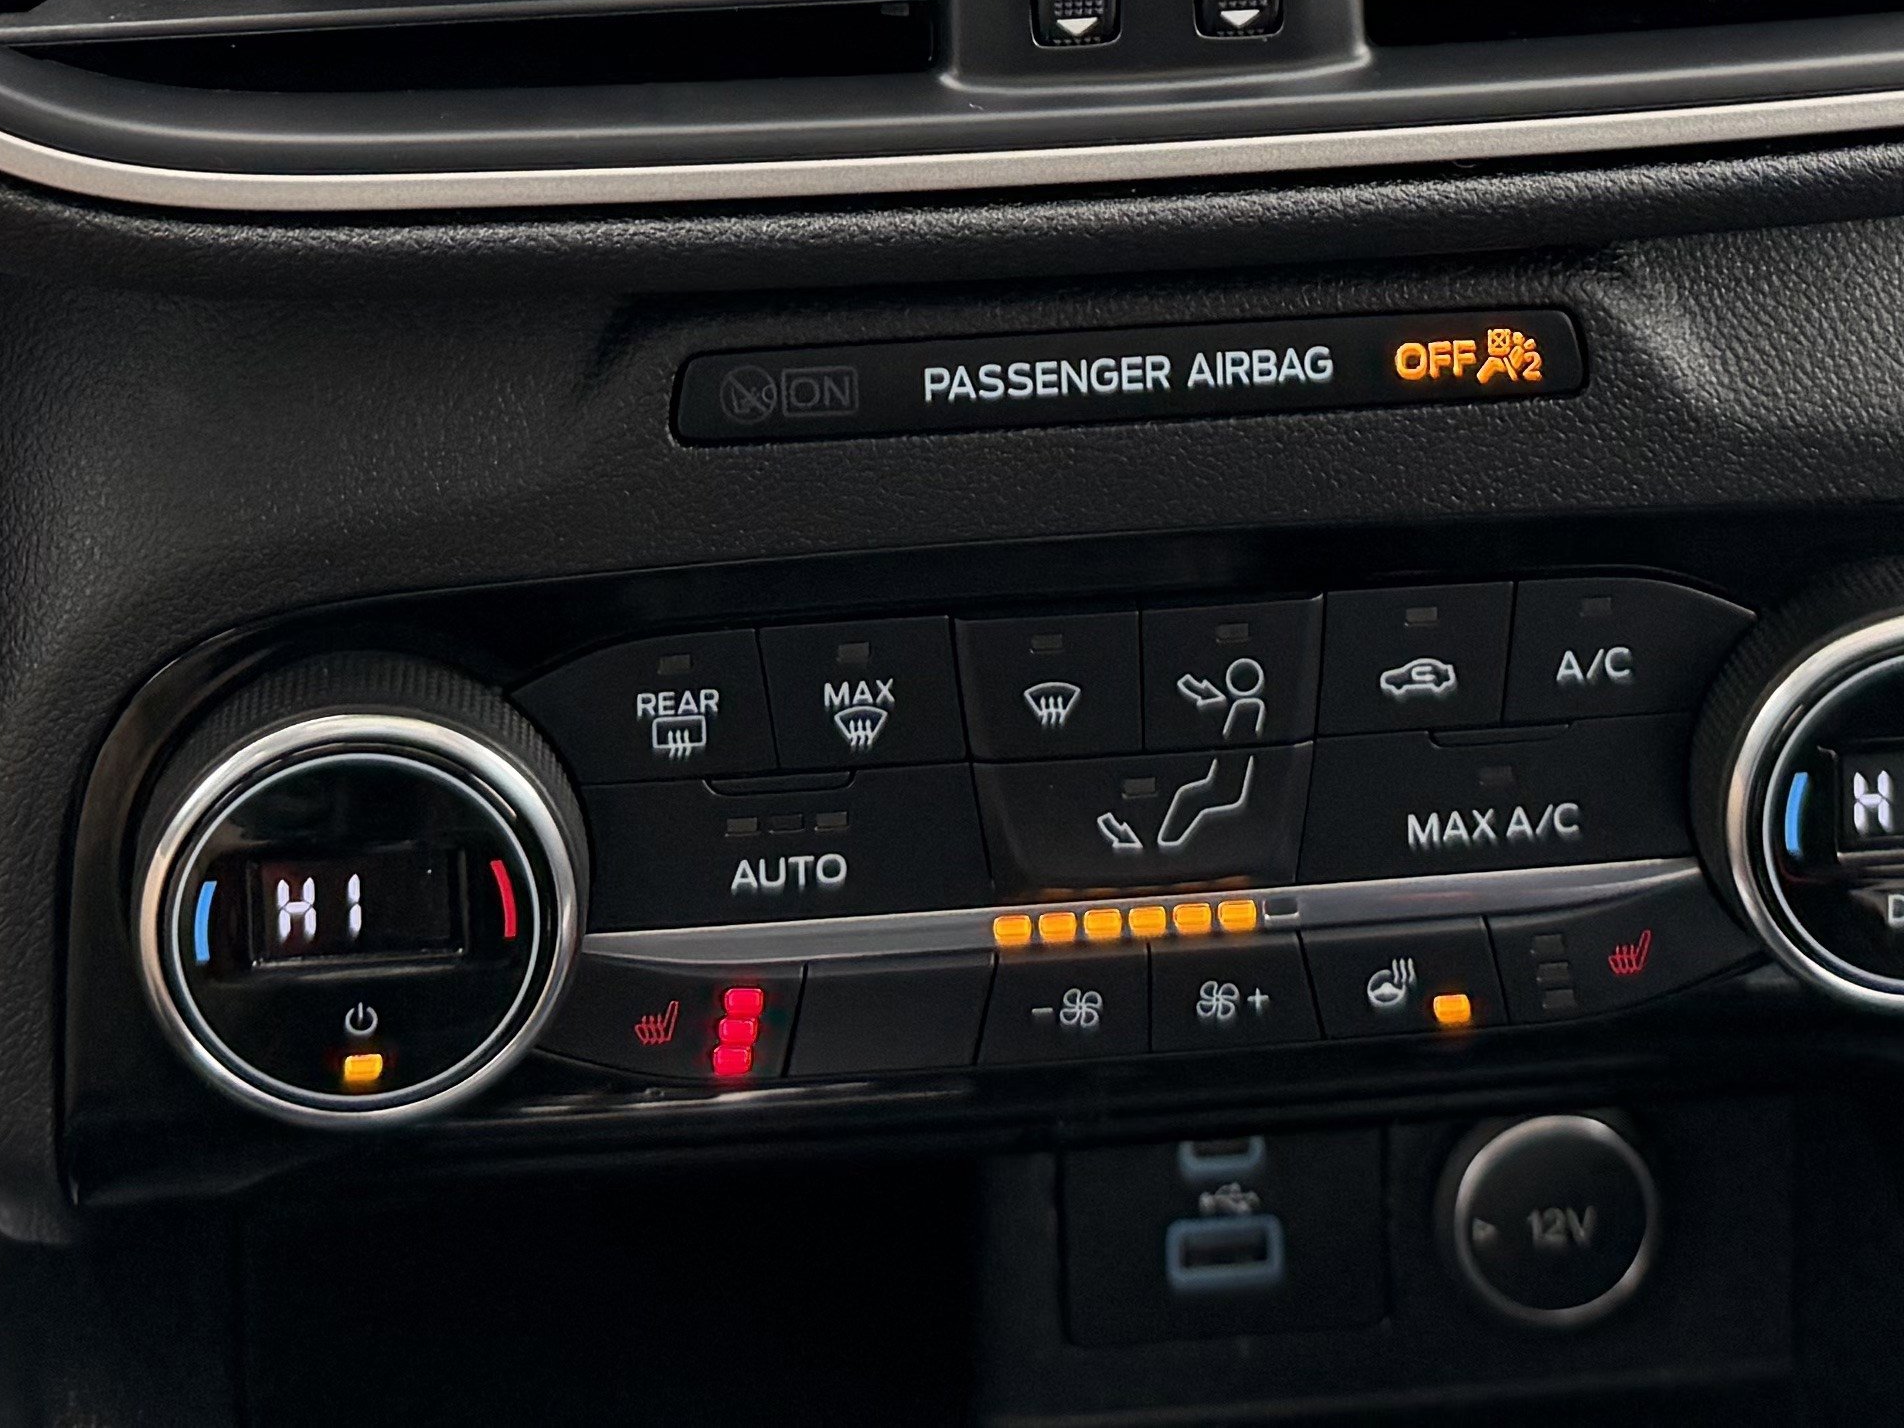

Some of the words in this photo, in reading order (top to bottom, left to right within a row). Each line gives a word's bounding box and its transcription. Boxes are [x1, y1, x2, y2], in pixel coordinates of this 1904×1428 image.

[924, 354, 1172, 403] PASSENGER
[1187, 345, 1335, 389] AIRBAG
[1394, 339, 1477, 381] OFF
[789, 375, 850, 407] ON
[1556, 646, 1632, 684] A/C
[636, 688, 720, 719] REAR
[823, 677, 896, 707] MAX
[1407, 808, 1497, 847] MAX
[1506, 802, 1580, 839] A/C
[731, 853, 848, 892] AUTO
[1527, 1206, 1597, 1246] 12V
